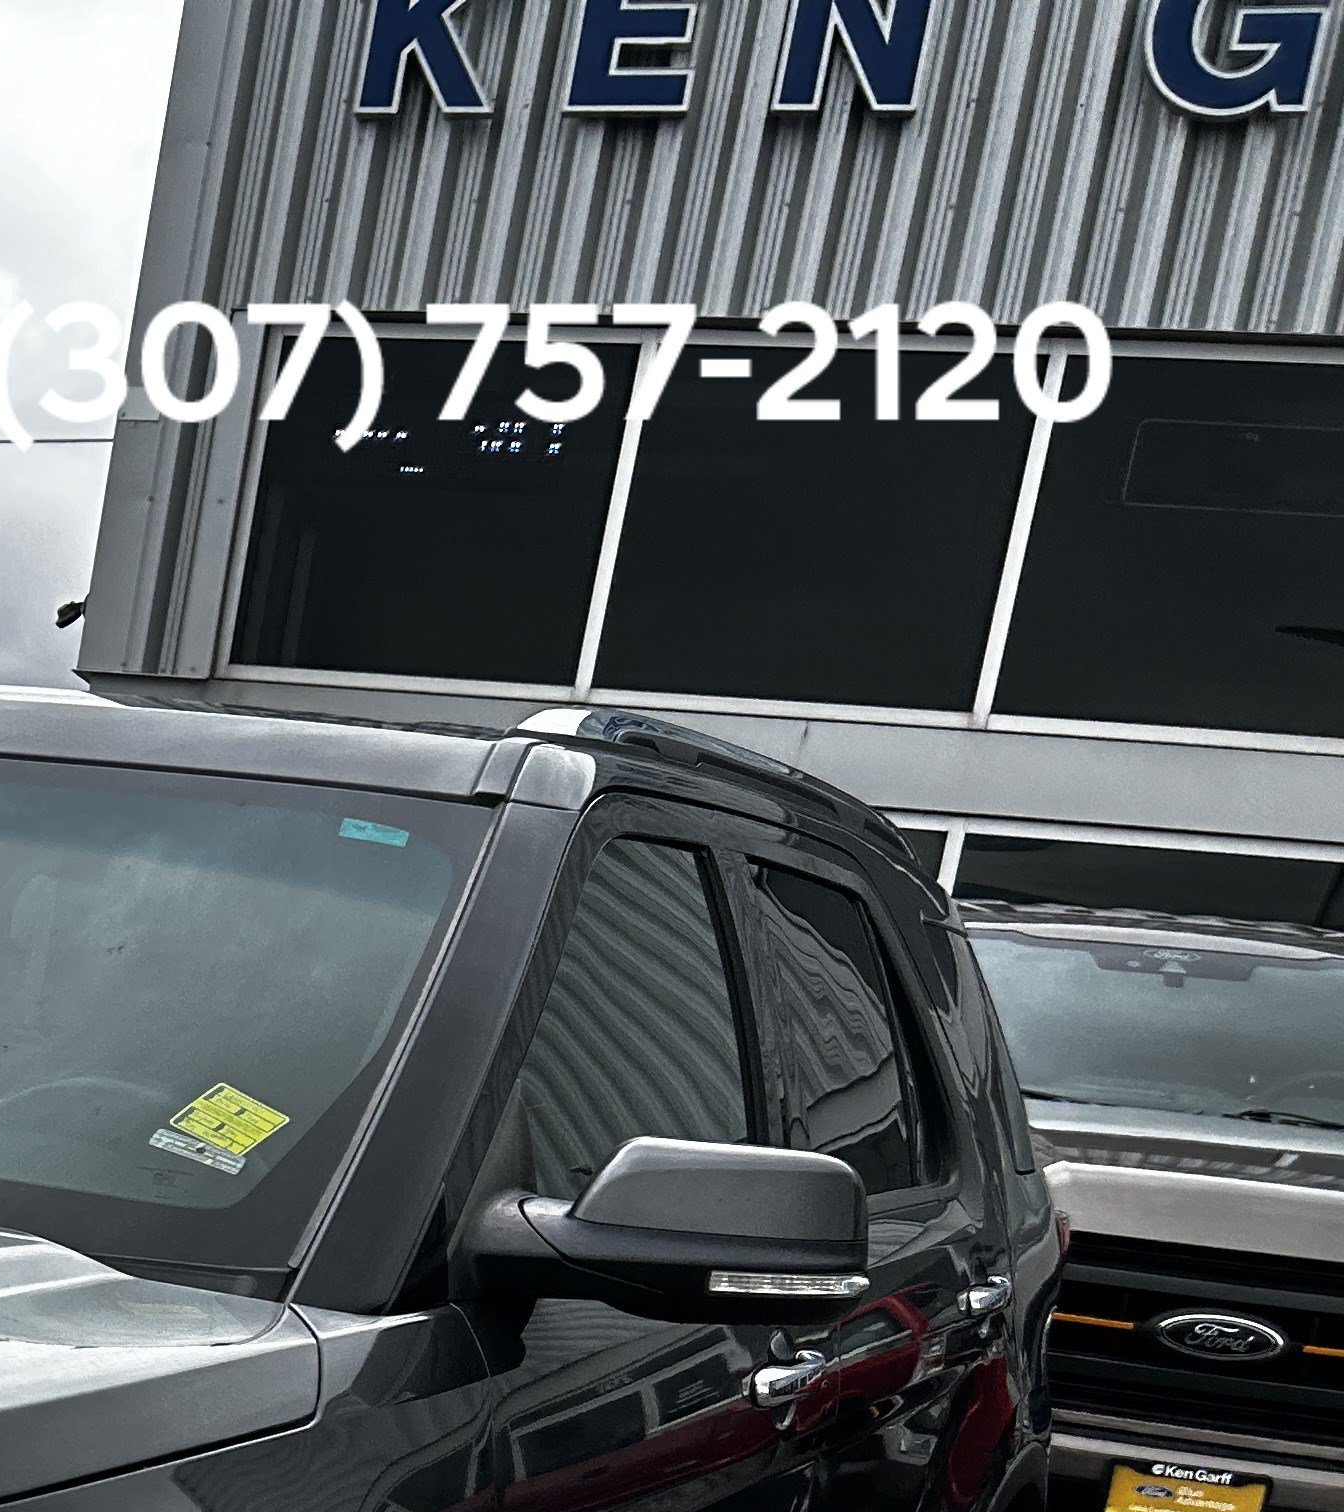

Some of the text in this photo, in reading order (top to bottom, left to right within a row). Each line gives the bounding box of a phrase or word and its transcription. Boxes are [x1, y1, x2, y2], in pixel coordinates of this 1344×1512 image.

[352, 0, 932, 113] KEN
[1185, 1322, 1256, 1353] Ford
[1164, 1465, 1233, 1485] Ken Garff
